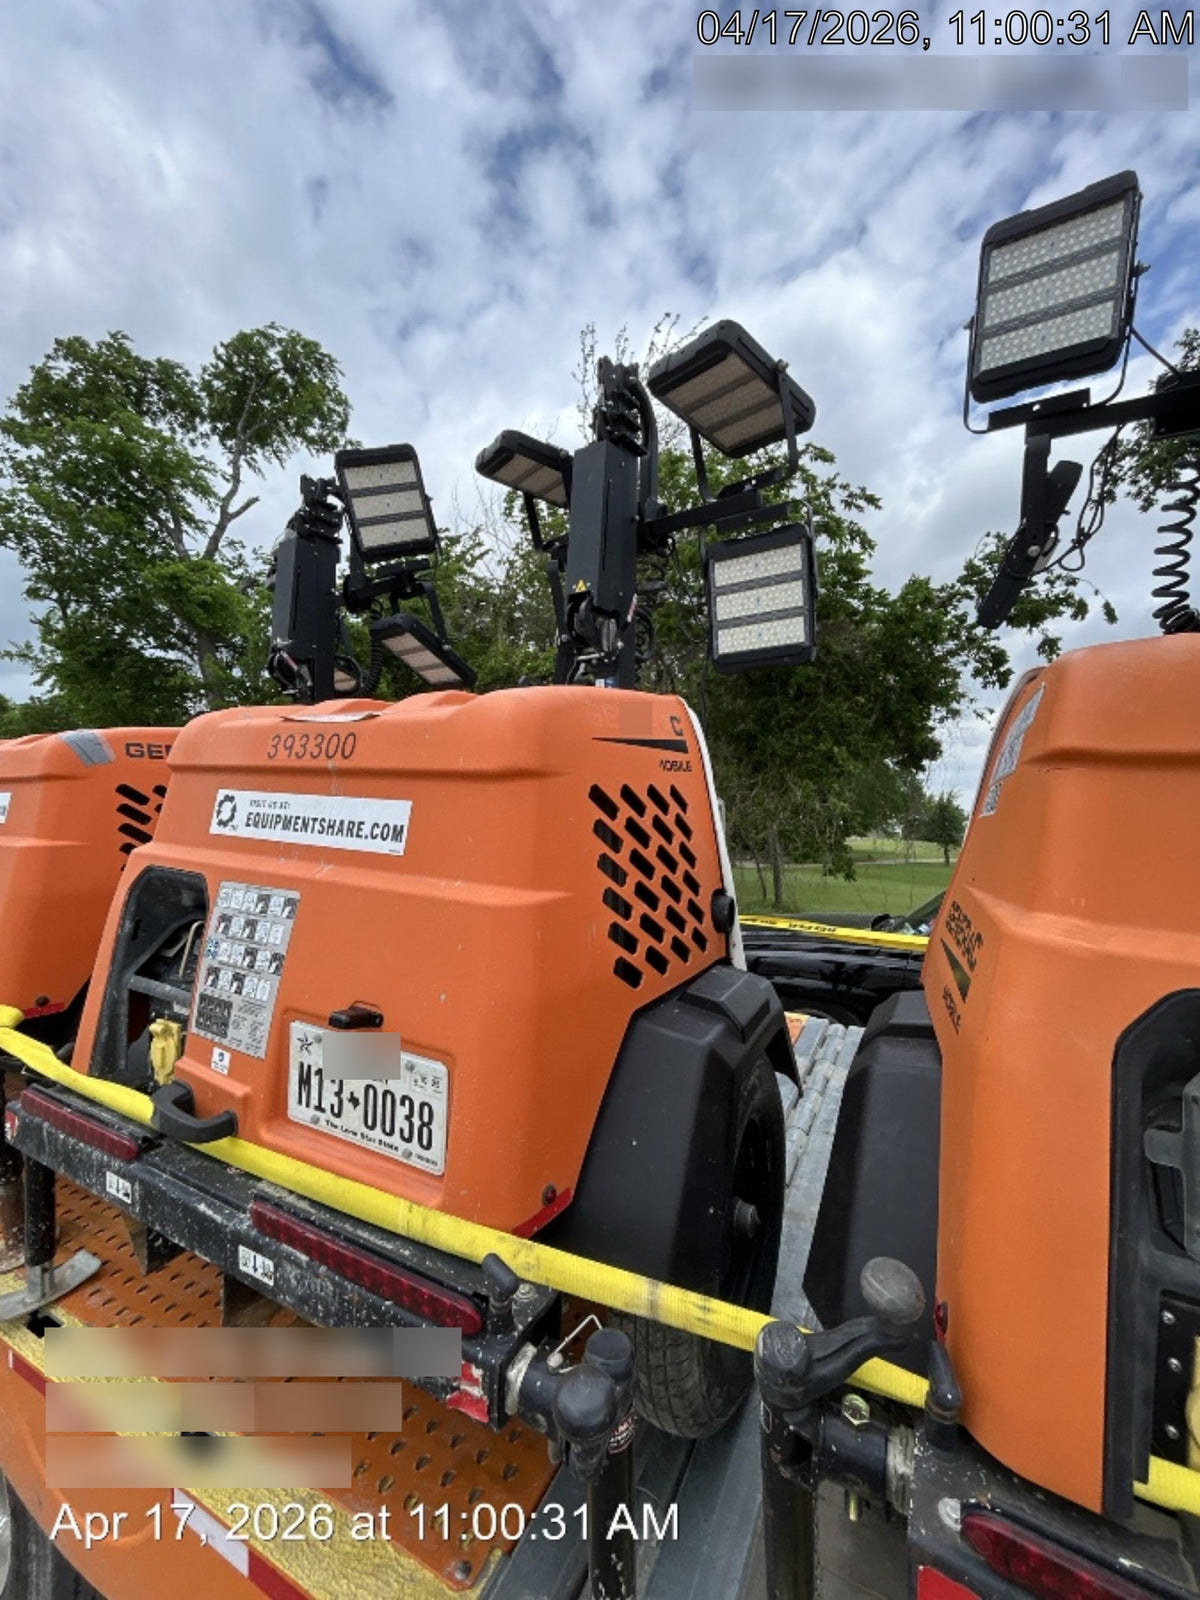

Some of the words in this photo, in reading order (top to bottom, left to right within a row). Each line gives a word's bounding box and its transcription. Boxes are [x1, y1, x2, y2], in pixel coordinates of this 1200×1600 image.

[267, 732, 357, 760] 393300
[245, 811, 405, 843] EQUIPMENTSHARE.COM
[325, 1119, 339, 1130] The
